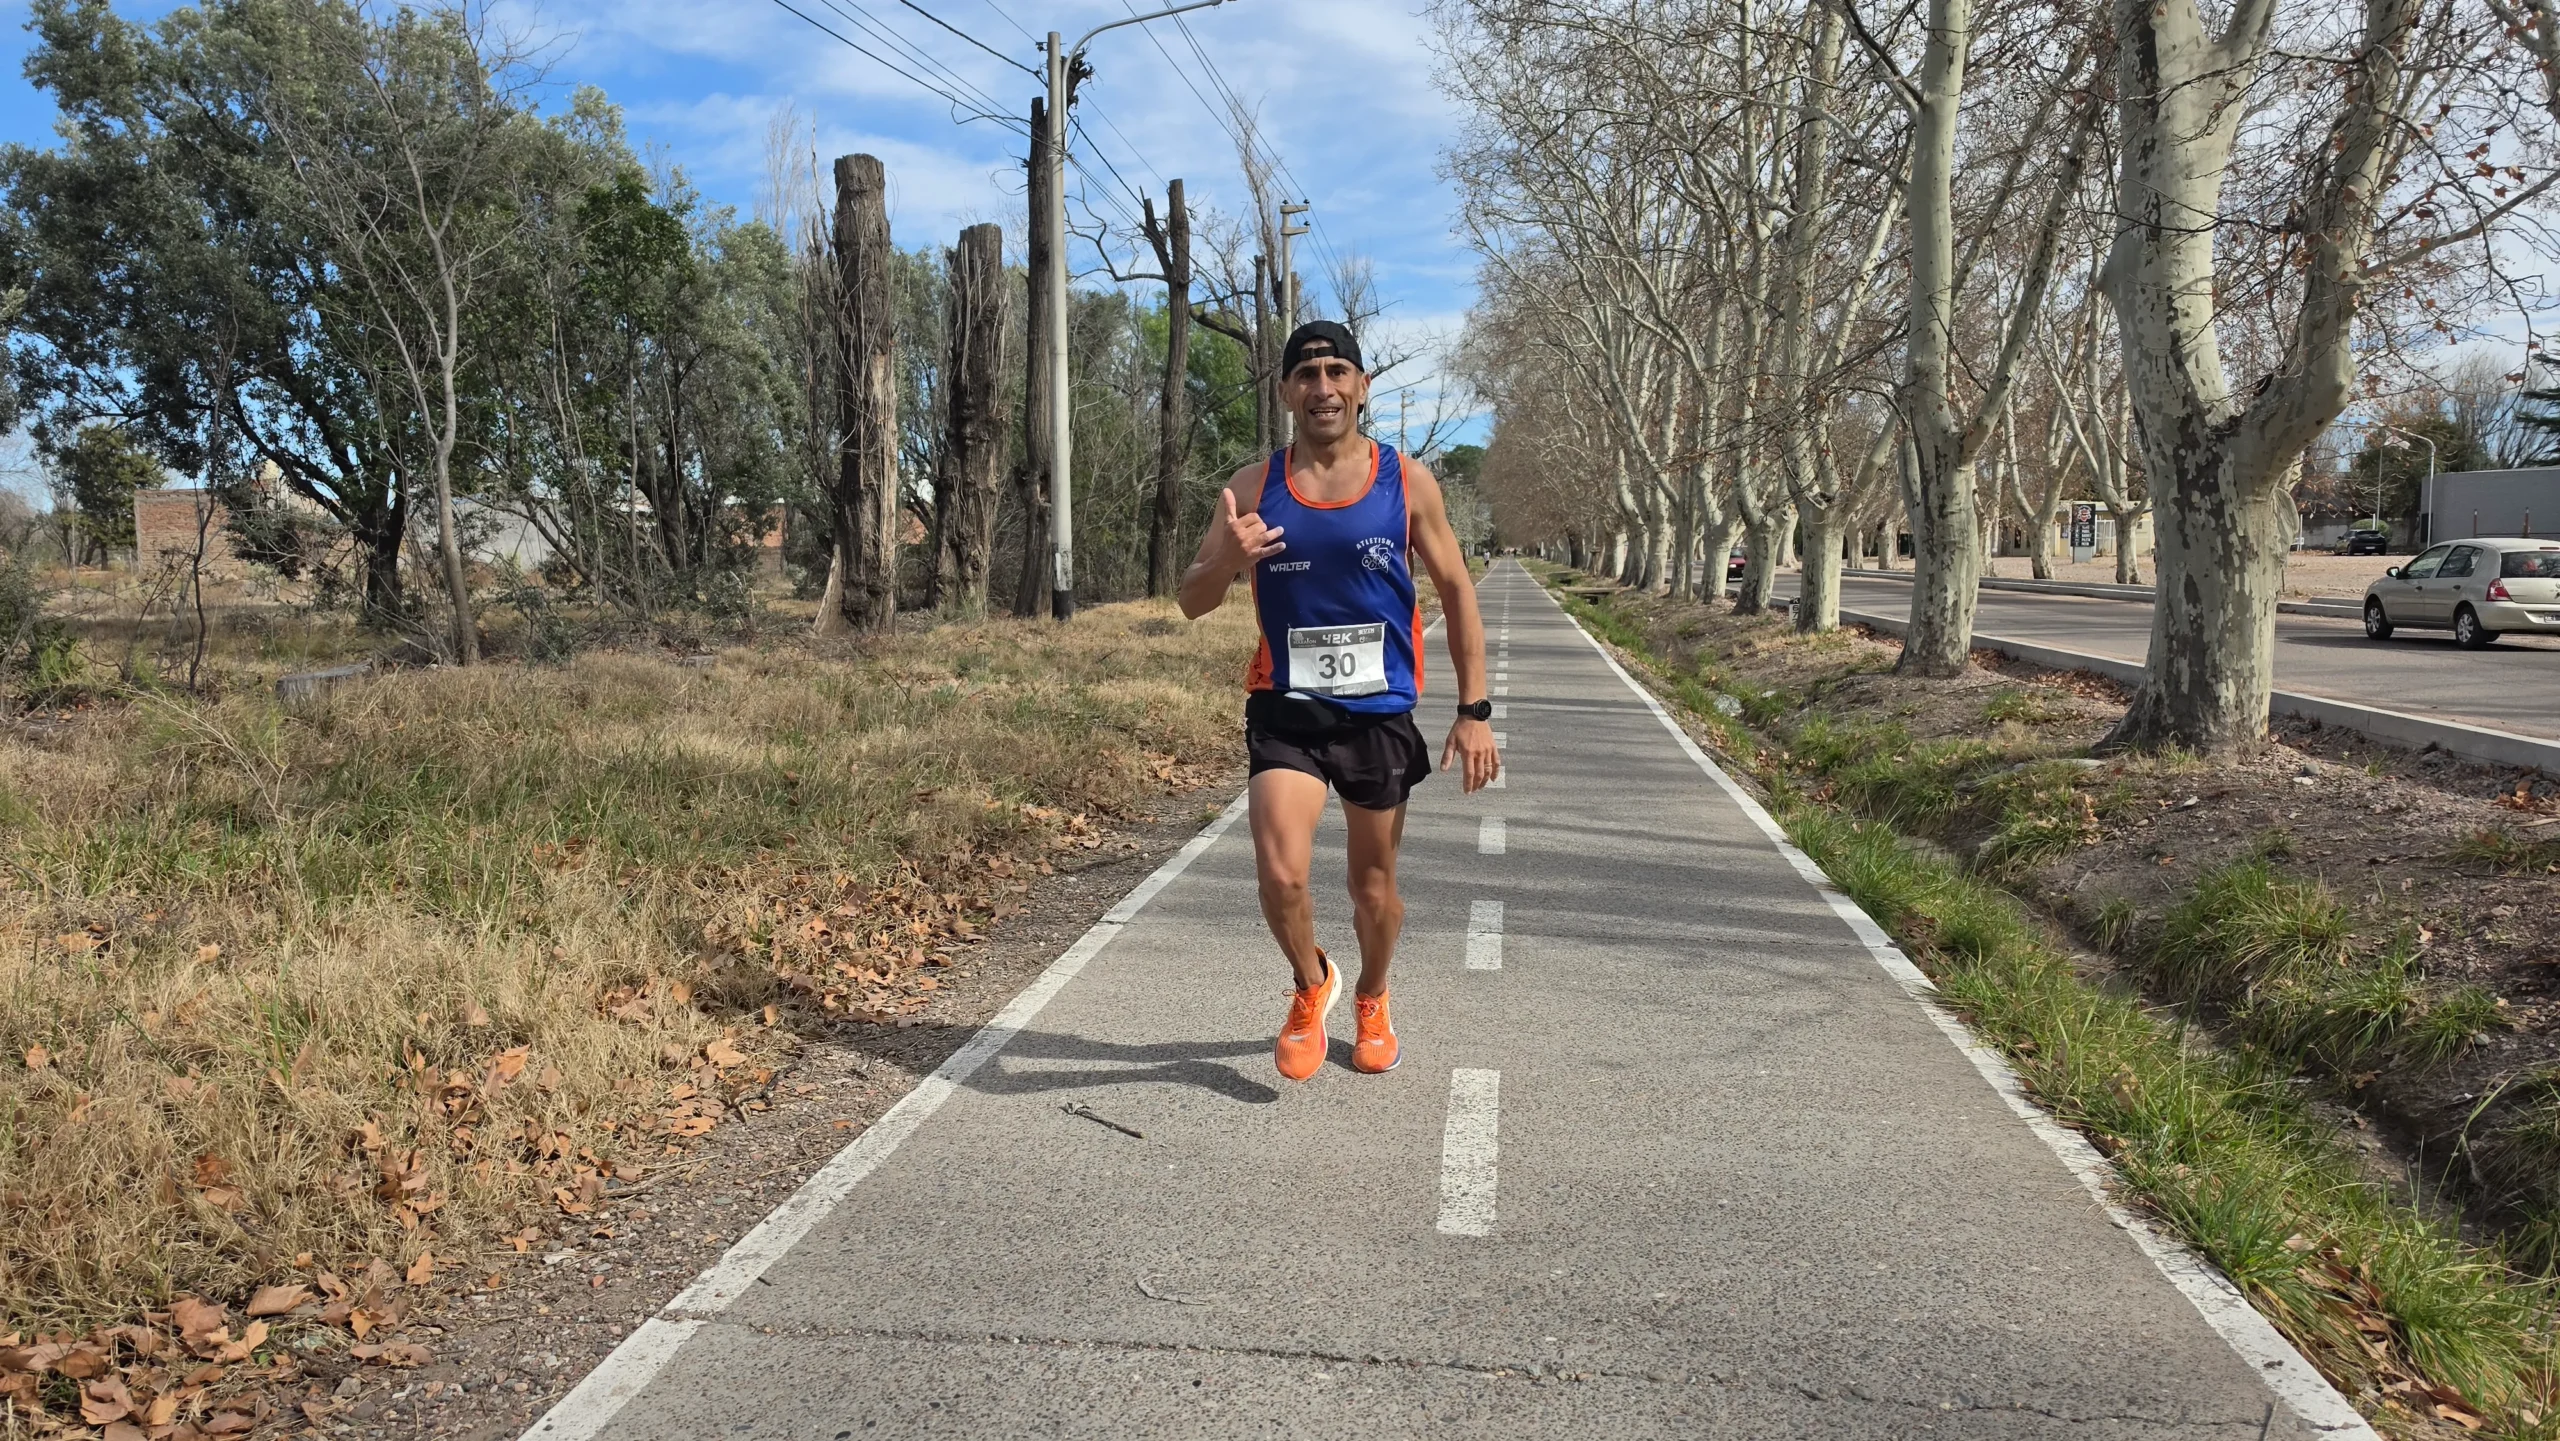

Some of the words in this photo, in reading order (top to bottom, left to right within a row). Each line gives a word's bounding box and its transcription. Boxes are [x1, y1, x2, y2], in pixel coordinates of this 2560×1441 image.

[1269, 561, 1311, 573] WALTER
[1322, 632, 1353, 644] 42K
[1318, 652, 1356, 680] 30
